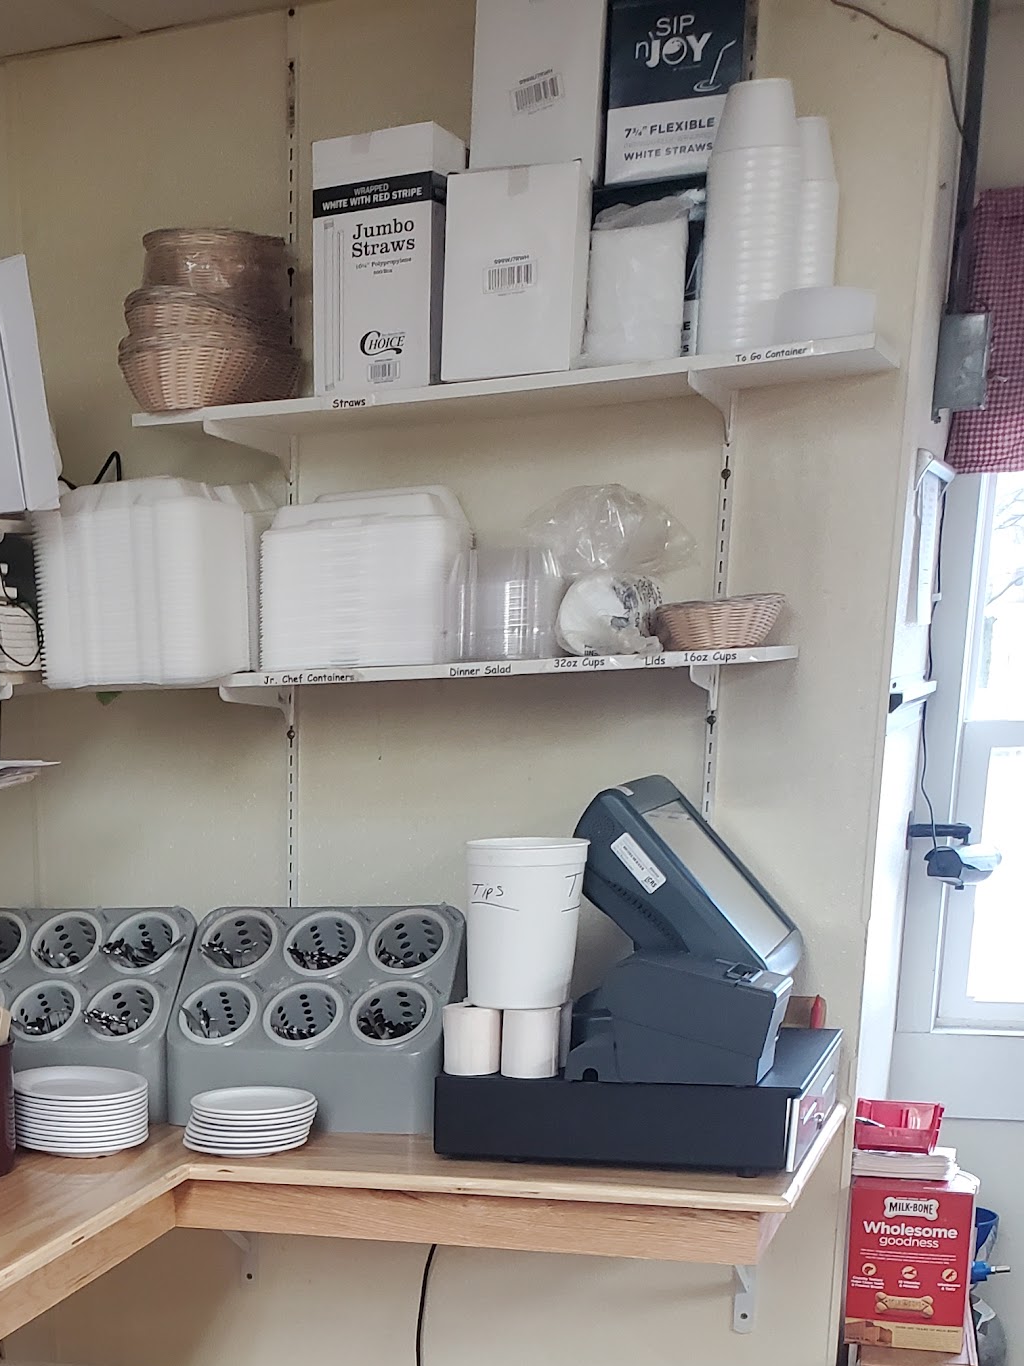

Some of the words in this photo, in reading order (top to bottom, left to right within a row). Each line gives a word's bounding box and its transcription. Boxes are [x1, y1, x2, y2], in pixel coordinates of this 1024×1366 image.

[656, 14, 695, 36] SIP
[649, 117, 716, 136] FLEXIBLE
[624, 148, 662, 161] WHITE
[665, 142, 714, 156] STRAWS
[353, 182, 390, 196] WRAPPED
[322, 198, 349, 211] WHITE
[349, 194, 371, 207] WITH
[372, 192, 391, 203] RED
[391, 186, 423, 200] STRIPE
[352, 218, 415, 240] Jumbo
[351, 238, 416, 258] Straws
[359, 330, 406, 357] CHOICE
[735, 354, 747, 363] To
[750, 352, 762, 361] Go
[765, 346, 808, 359] Container
[332, 398, 366, 408] Straws
[553, 658, 578, 668] 32oz
[581, 657, 605, 668] Cups
[645, 655, 666, 666] Lids
[683, 652, 709, 663] 16oz
[712, 651, 737, 662] Cups
[263, 675, 278, 685] Jr.
[281, 673, 303, 683] Chef
[306, 672, 355, 683] Containers
[449, 666, 481, 677] Dinner
[484, 664, 512, 675] Salad
[471, 883, 504, 900] Tips
[888, 1201, 934, 1215] MILK-BONE
[862, 1220, 959, 1240] Wholesome
[878, 1235, 940, 1249] goodness
